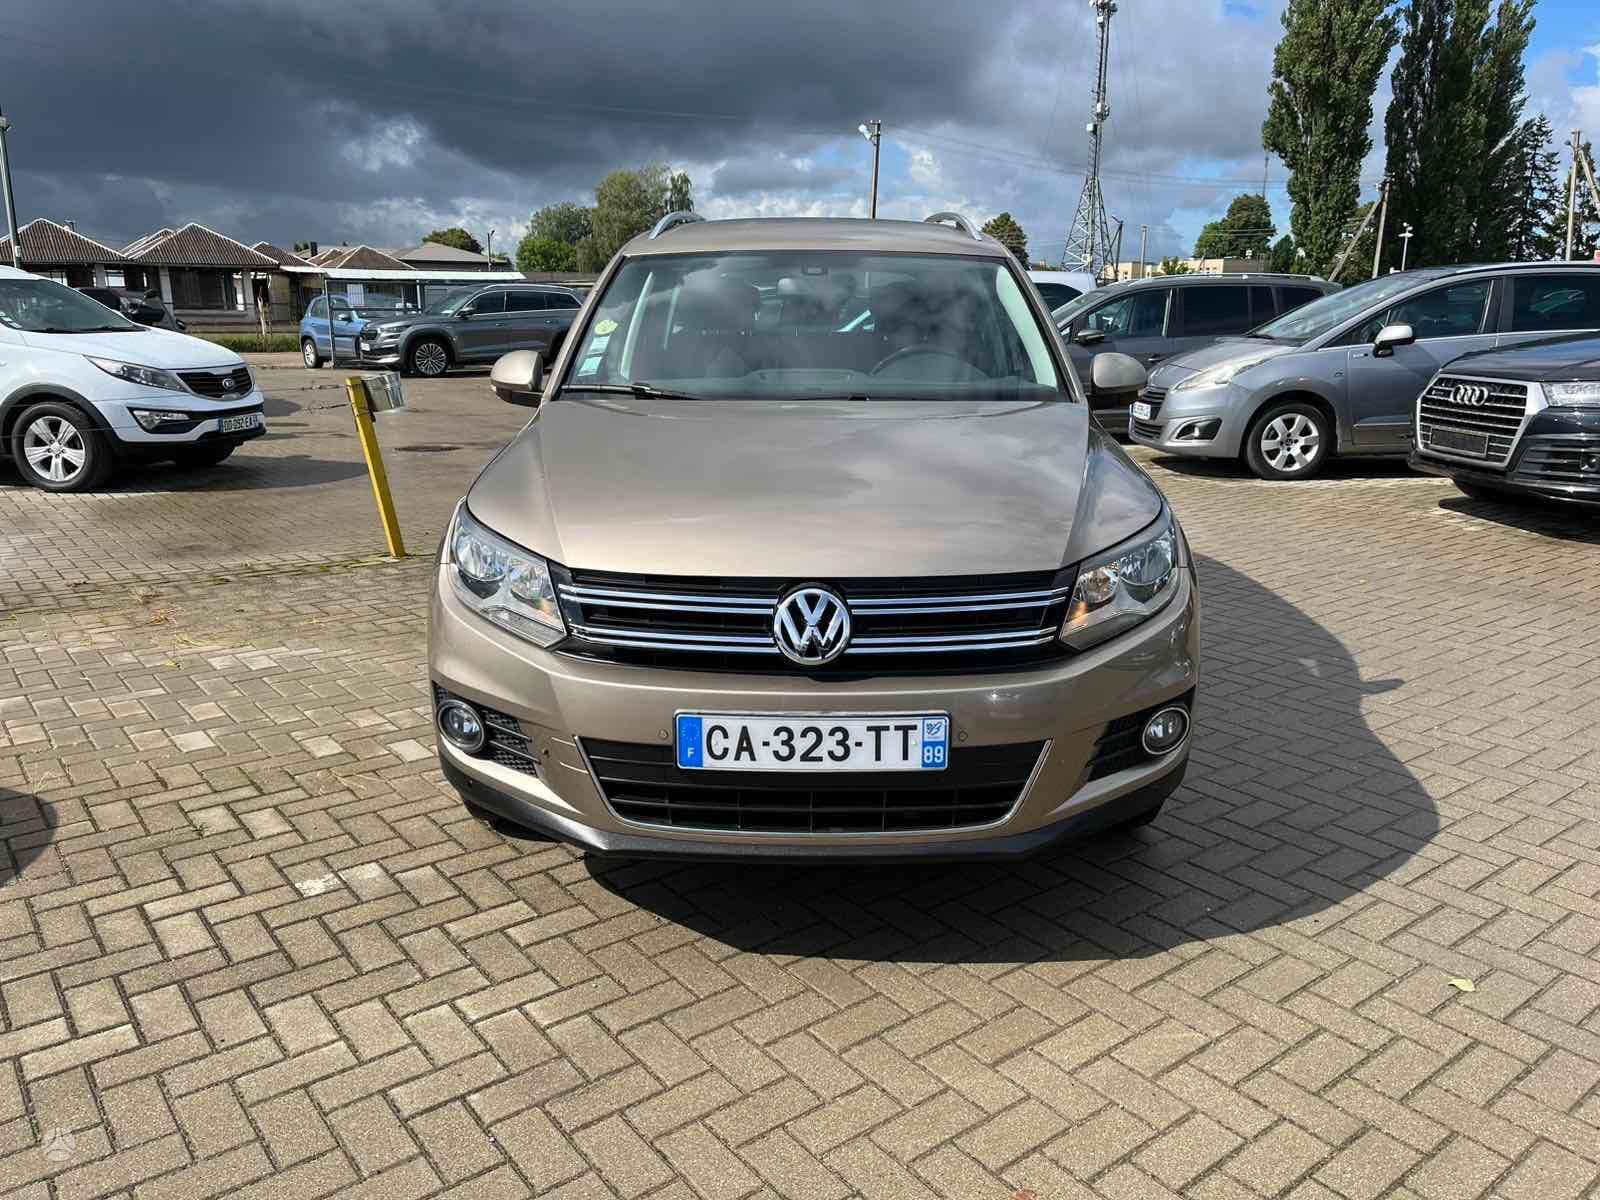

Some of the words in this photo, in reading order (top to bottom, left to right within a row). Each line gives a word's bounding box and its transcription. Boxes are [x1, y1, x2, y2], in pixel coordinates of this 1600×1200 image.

[705, 724, 918, 762] CA-323-TT
[687, 747, 695, 759] F
[923, 745, 944, 764] 89
